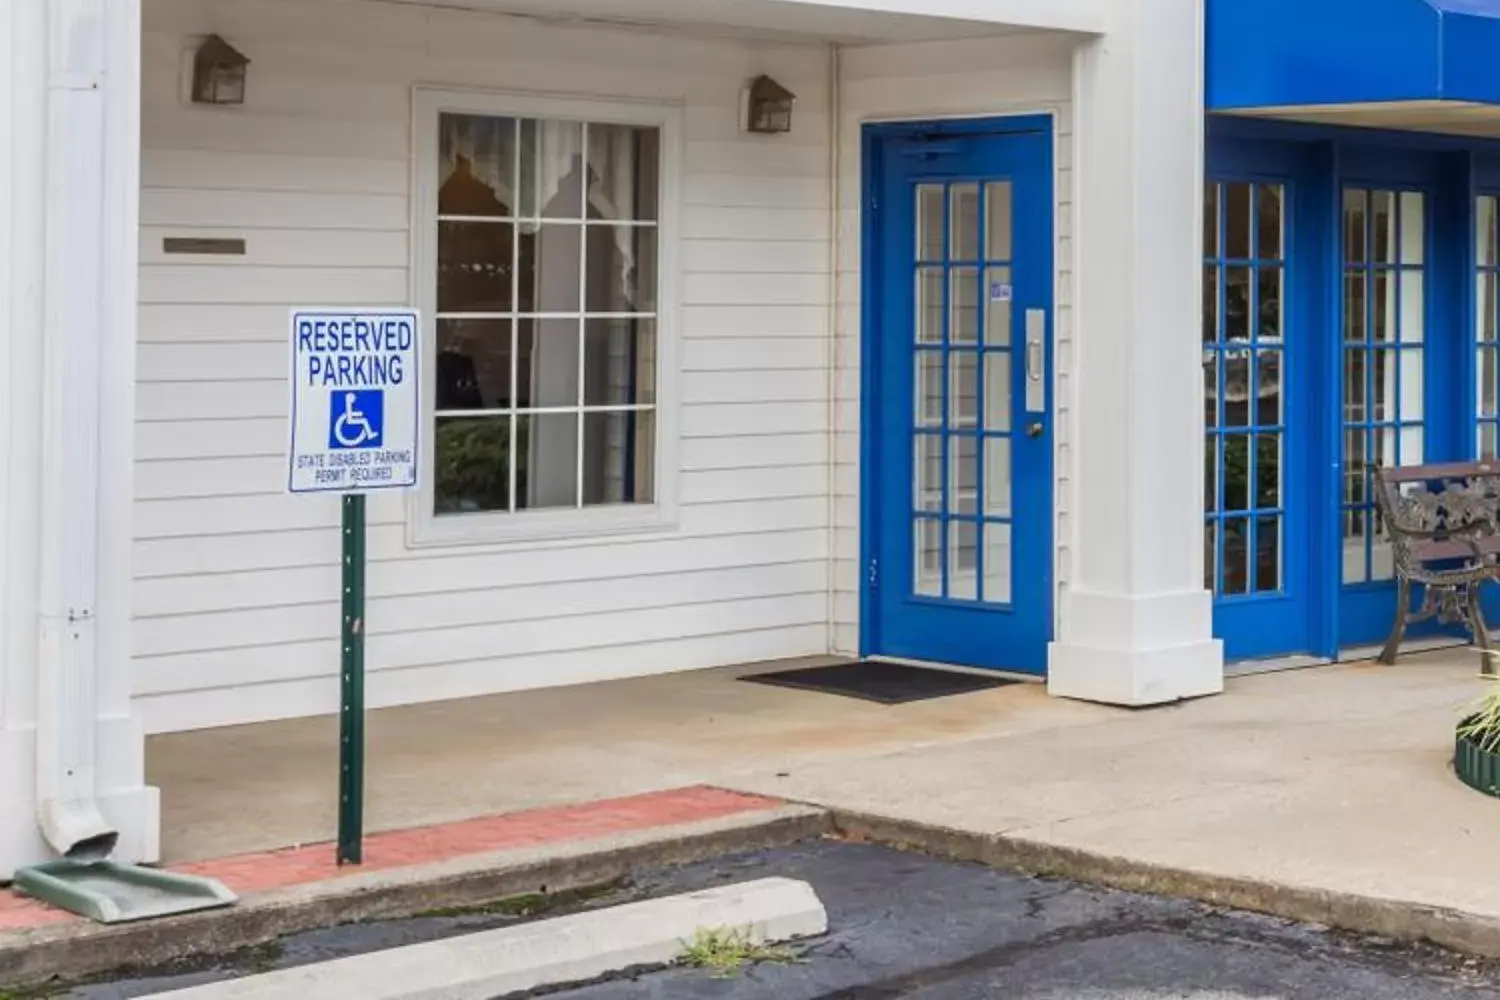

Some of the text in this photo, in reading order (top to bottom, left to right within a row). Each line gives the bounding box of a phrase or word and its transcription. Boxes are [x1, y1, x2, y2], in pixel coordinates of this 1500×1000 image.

[300, 321, 411, 352] RESERVED
[308, 354, 403, 387] PARKING
[297, 449, 412, 468] STATE DISABLED PARKING
[314, 467, 346, 483] PERMIT
[350, 466, 393, 481] REQUIRED
